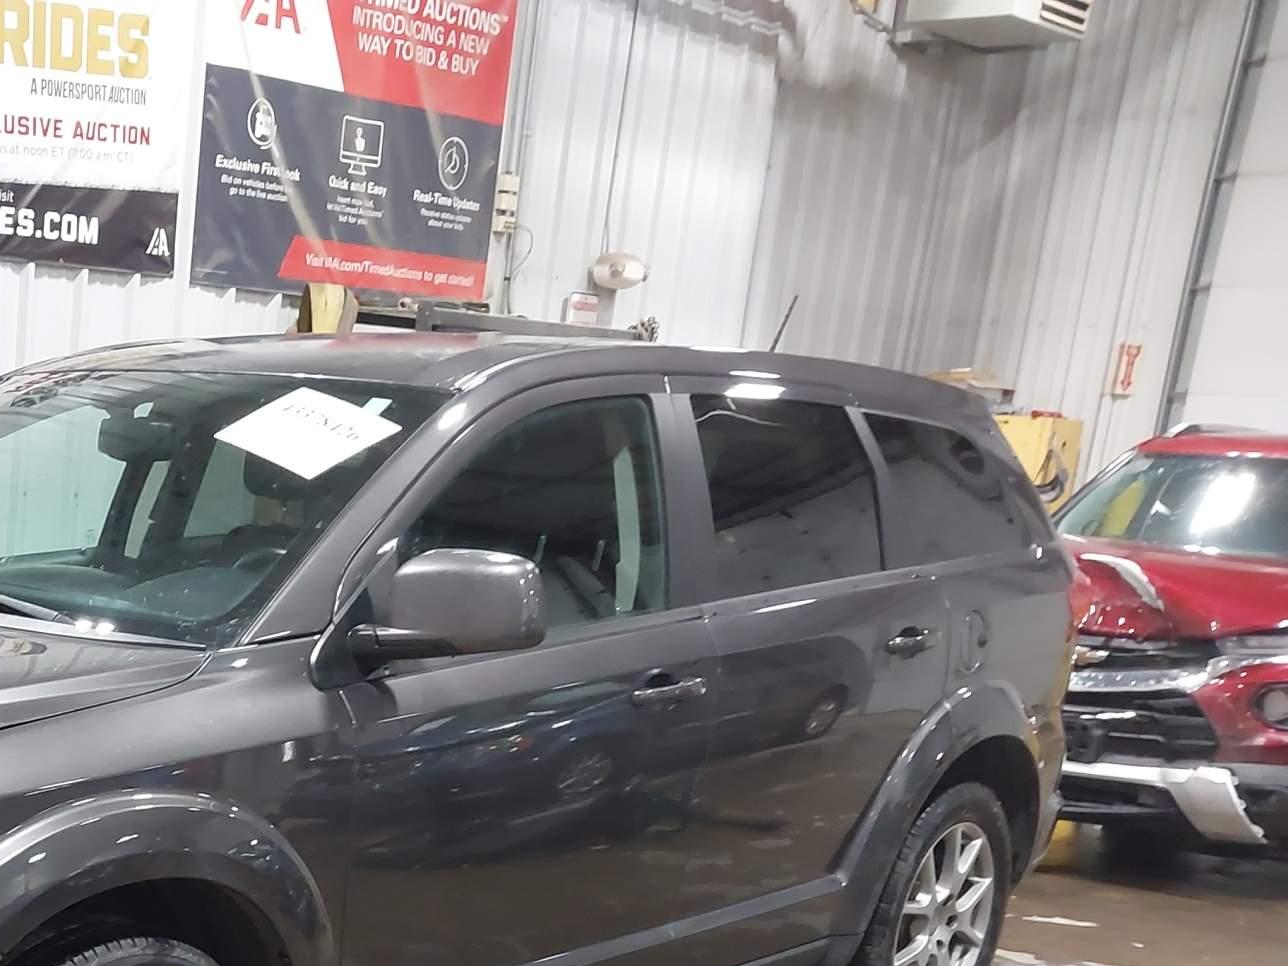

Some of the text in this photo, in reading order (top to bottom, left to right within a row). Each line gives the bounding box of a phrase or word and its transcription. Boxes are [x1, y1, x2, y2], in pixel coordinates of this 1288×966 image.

[358, 32, 480, 76] WAY TO BID & BUY
[446, 30, 457, 48] A
[459, 32, 489, 56] NEW
[30, 77, 147, 106] A POWERSPORT AUCTION
[72, 121, 151, 146] AUCTION
[214, 153, 260, 175] Exclusive
[328, 174, 388, 198] Quick and Easy
[412, 189, 453, 207] Real-Time
